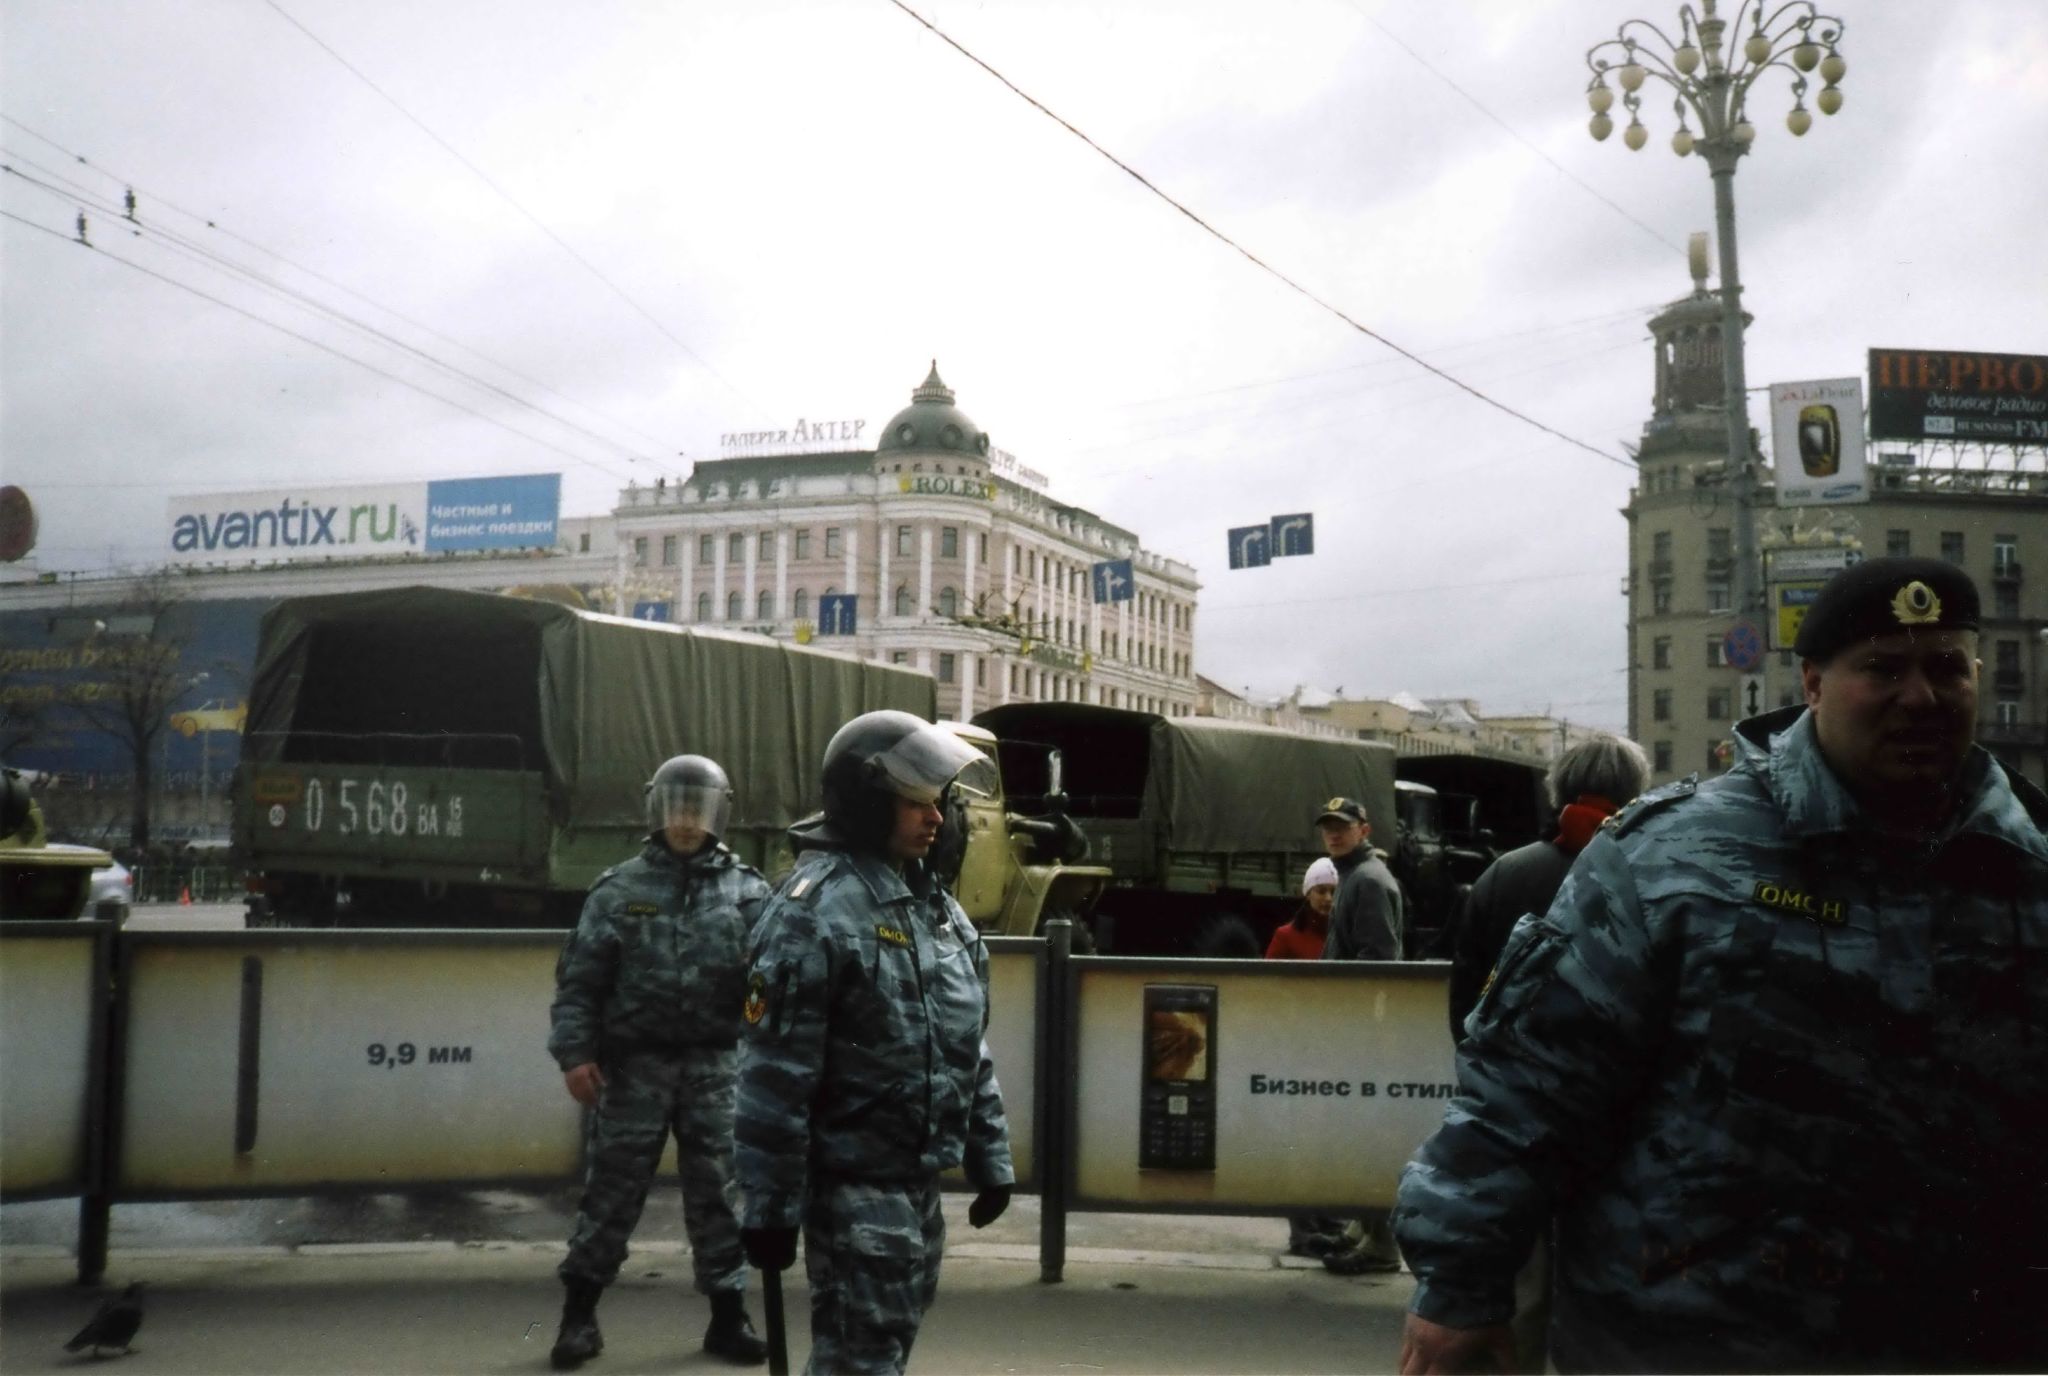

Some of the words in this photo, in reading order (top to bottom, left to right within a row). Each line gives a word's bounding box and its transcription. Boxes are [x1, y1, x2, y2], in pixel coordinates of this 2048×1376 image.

[1879, 354, 2048, 393] ПЕРВО
[1992, 396, 2046, 416] радио
[916, 477, 988, 500] ROLEX
[431, 503, 497, 520] Частные
[501, 503, 513, 516] и
[171, 496, 398, 553] avantix.ru
[430, 520, 485, 537] бизнес
[489, 518, 553, 536] поездки
[367, 1042, 417, 1070] 9,9
[429, 1046, 472, 1064] мм
[1250, 1074, 1351, 1097] Бизнес
[1360, 1082, 1377, 1097] в
